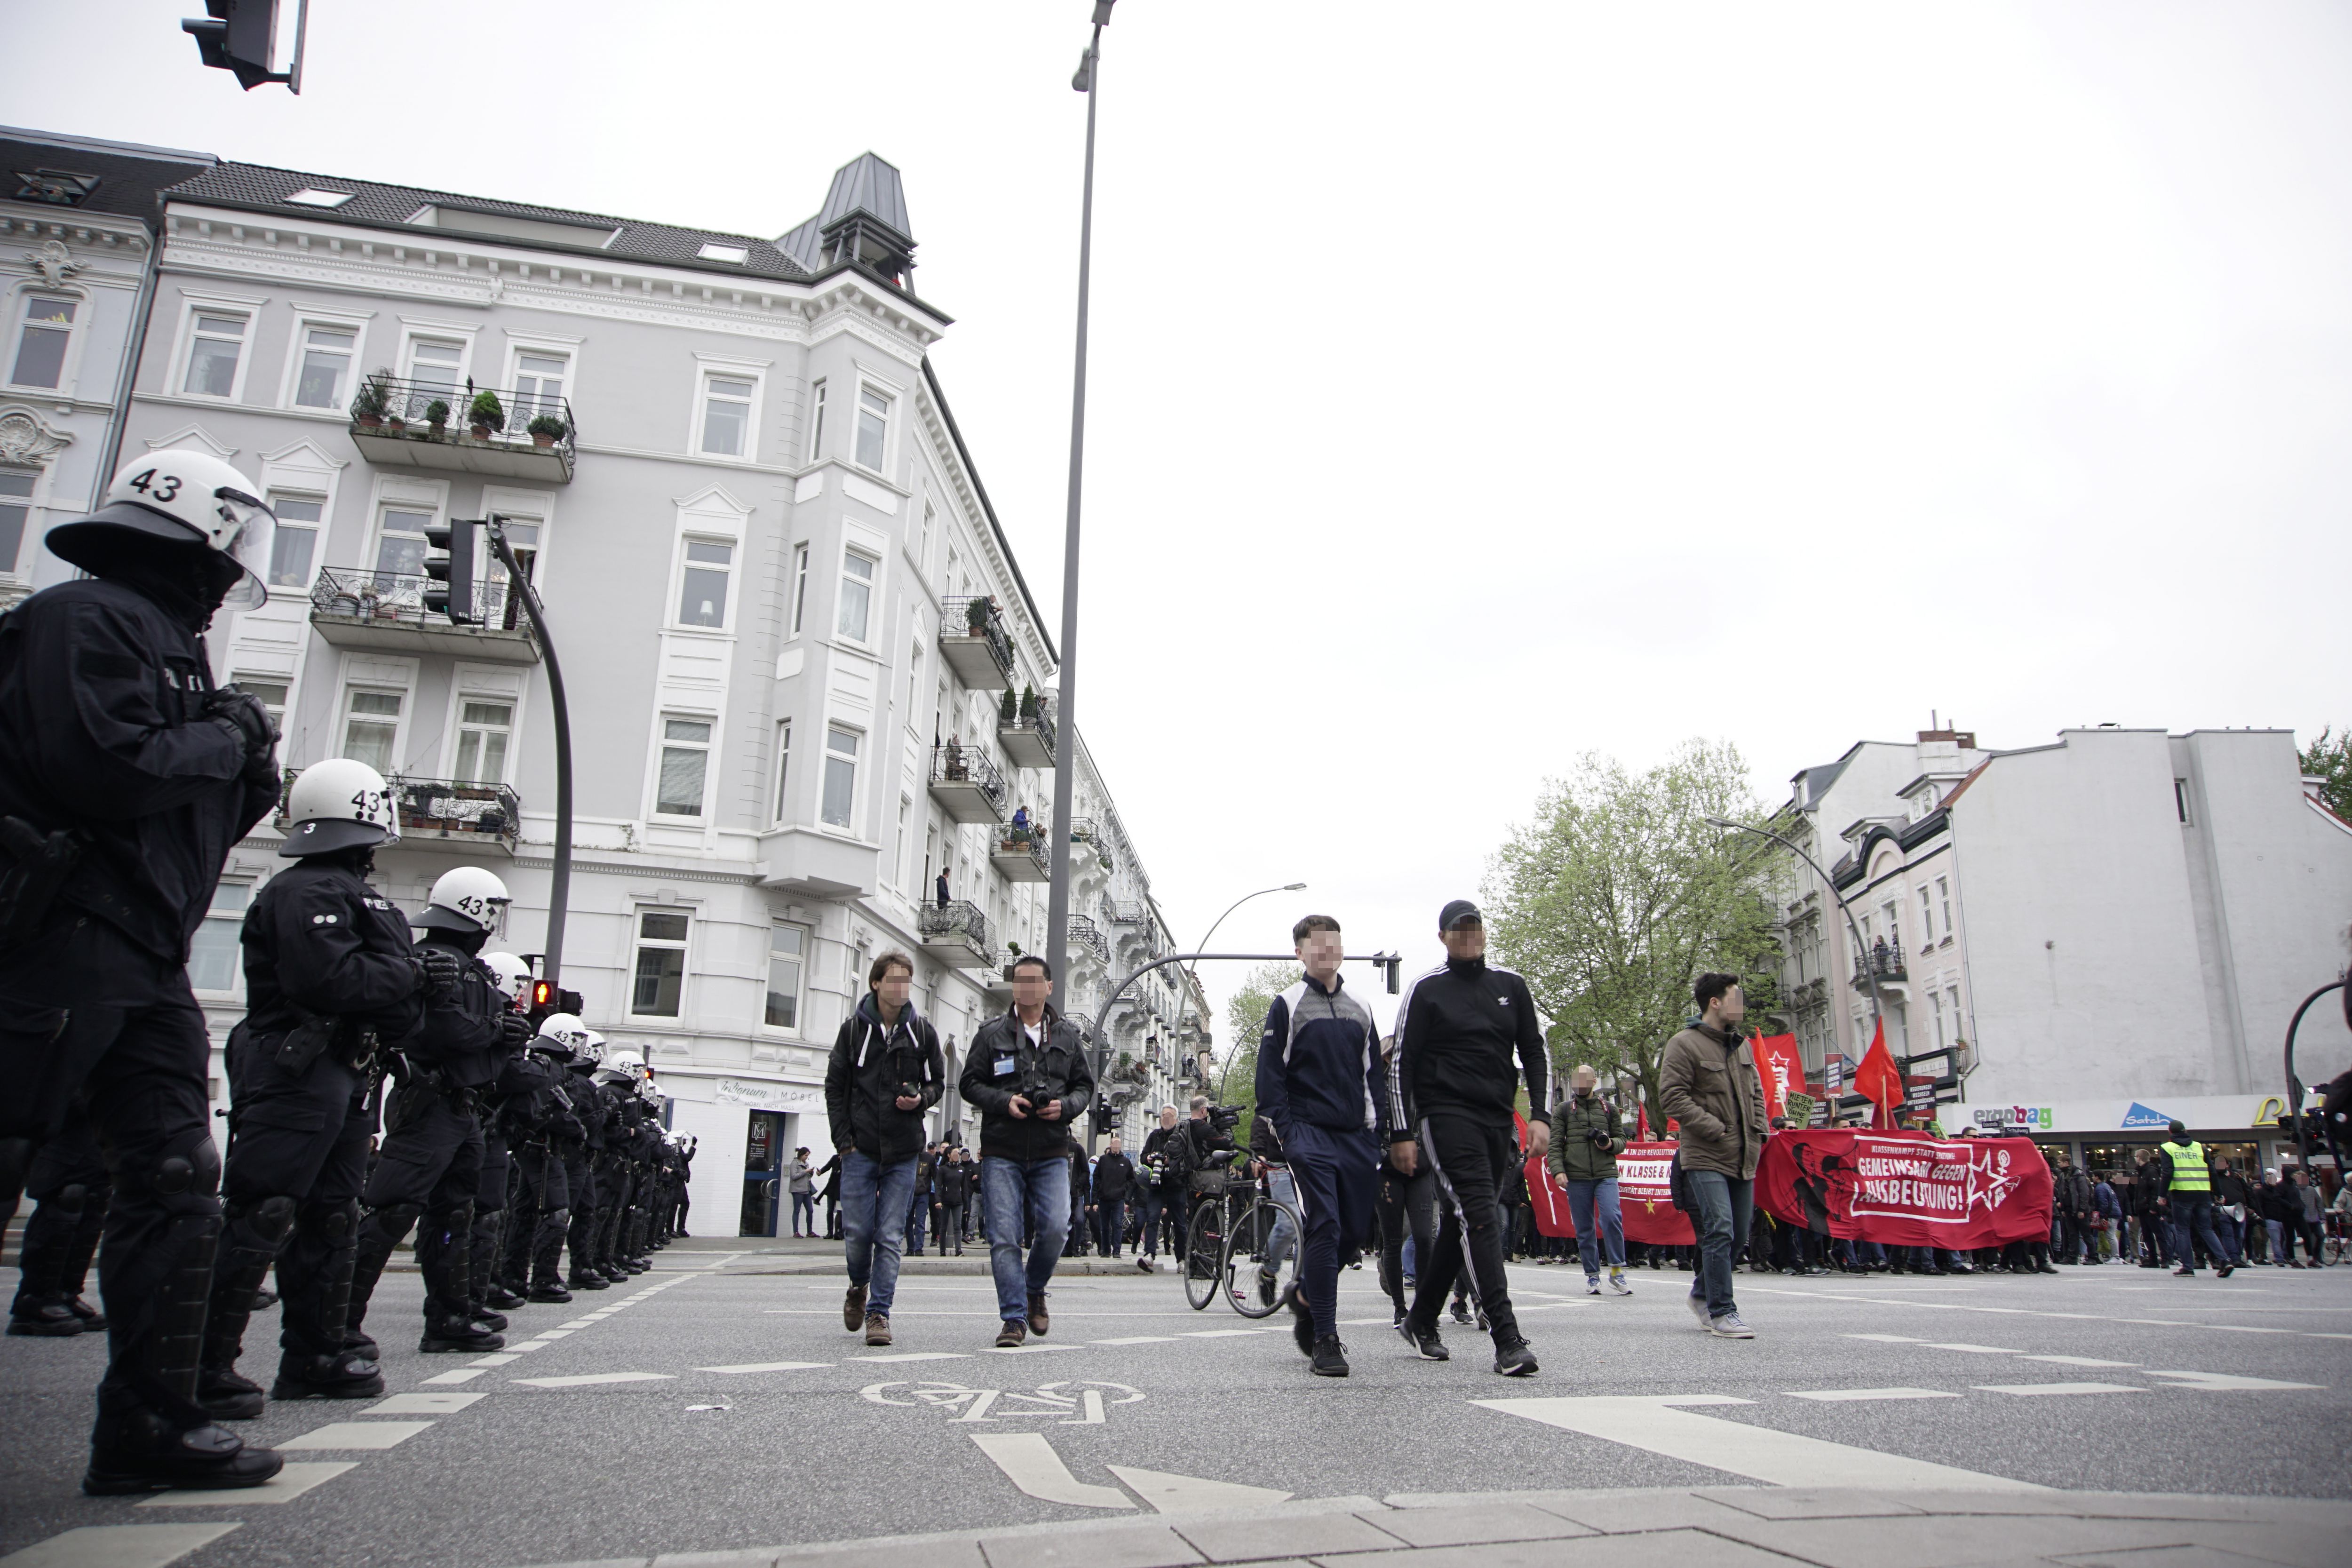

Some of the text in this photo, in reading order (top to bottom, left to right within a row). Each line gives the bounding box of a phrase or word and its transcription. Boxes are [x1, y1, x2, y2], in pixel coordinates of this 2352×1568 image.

[129, 468, 182, 502] 43
[351, 790, 379, 812] 43
[304, 823, 316, 834] 3
[458, 896, 483, 915] 43
[554, 1030, 568, 1042] 43
[1789, 1092, 1813, 1105] MIETEN
[1788, 1099, 1811, 1113] RUNTER
[1788, 1107, 1806, 1118] ÖHNE
[1973, 1106, 2052, 1129] ergobag
[1872, 1145, 1915, 1155] KLASSENKAMPF
[1916, 1148, 1935, 1158] STATT
[1627, 1166, 1657, 1178] KLASSE
[1659, 1166, 1664, 1178] &
[1859, 1157, 1966, 1181] GEMEINSAM GEGEN
[1859, 1180, 1963, 1210] AUSBEUTUNG!
